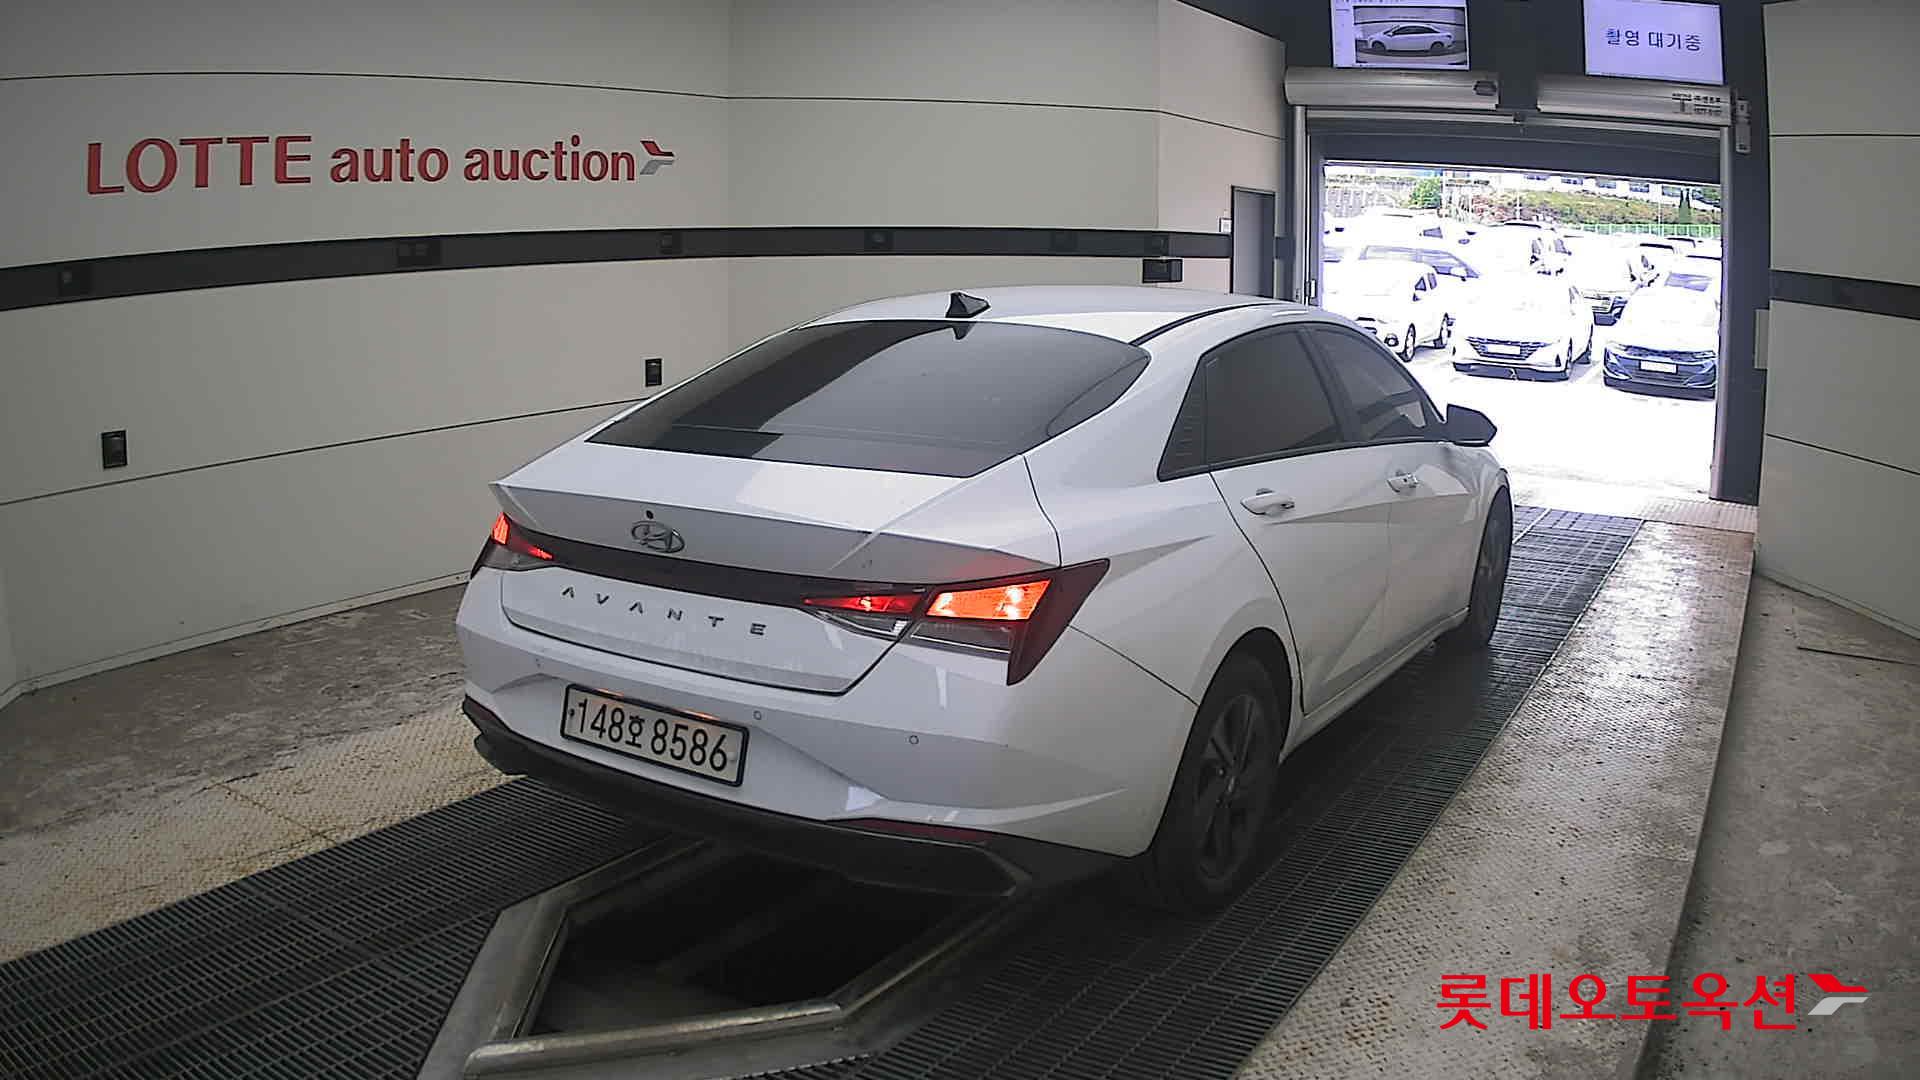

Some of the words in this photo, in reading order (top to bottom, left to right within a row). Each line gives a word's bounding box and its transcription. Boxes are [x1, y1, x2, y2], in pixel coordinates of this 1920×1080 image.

[1648, 31, 1701, 52] 대기중
[87, 135, 312, 195] LOTTE
[330, 138, 450, 183] auto
[463, 134, 636, 182] auction
[561, 585, 768, 637] AVANTE
[577, 697, 644, 750] 148호
[650, 718, 728, 773] 8586
